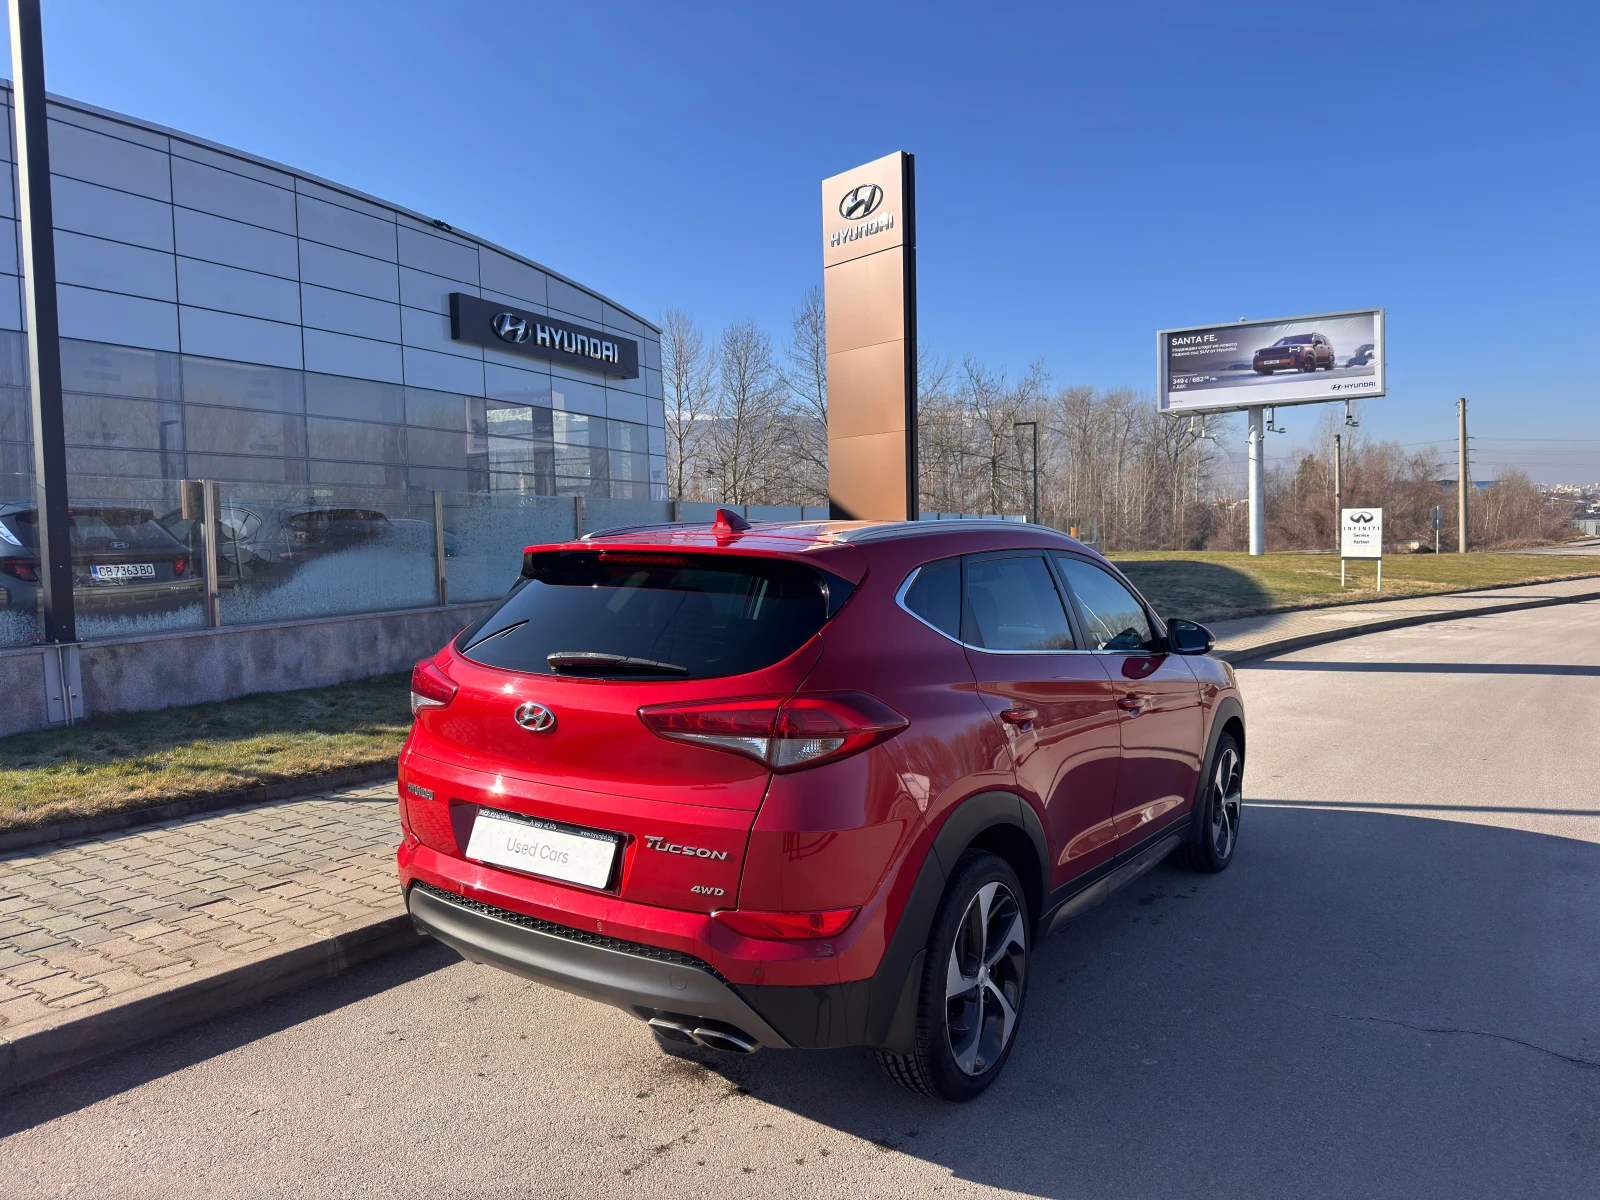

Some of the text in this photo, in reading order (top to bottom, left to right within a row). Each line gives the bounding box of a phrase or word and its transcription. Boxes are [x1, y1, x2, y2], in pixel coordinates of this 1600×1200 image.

[831, 212, 894, 248] HYUNDAI
[537, 323, 619, 364] HYUNDAI
[1171, 334, 1218, 346] SANTA FE.
[1344, 381, 1376, 389] HYUNDAI
[506, 837, 569, 864] Used Cars
[644, 835, 728, 860] TUCSON
[690, 885, 725, 896] 4WD
